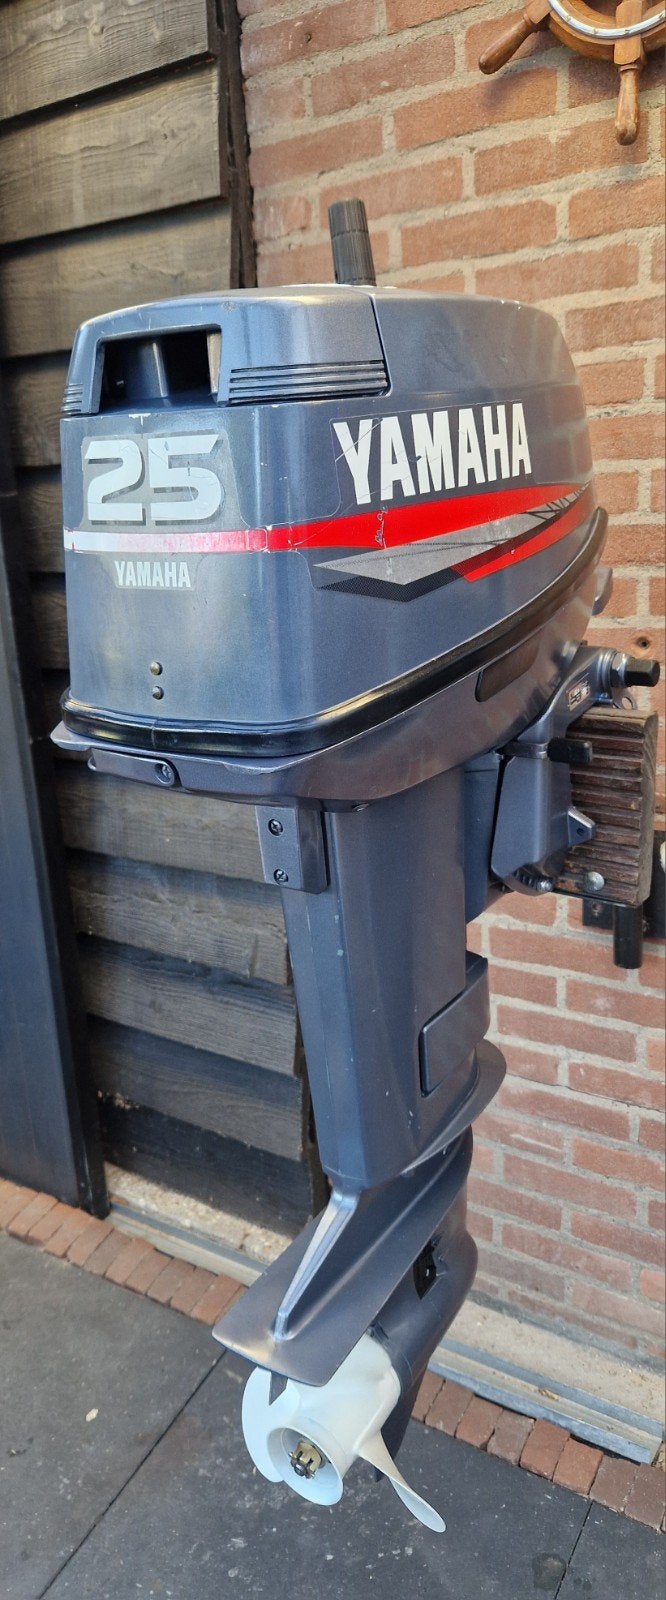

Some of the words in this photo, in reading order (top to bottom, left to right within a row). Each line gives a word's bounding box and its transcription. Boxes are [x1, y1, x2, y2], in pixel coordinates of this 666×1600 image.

[84, 434, 225, 523] 25
[333, 402, 532, 505] YAMAHA
[114, 560, 191, 588] YAMAHA
